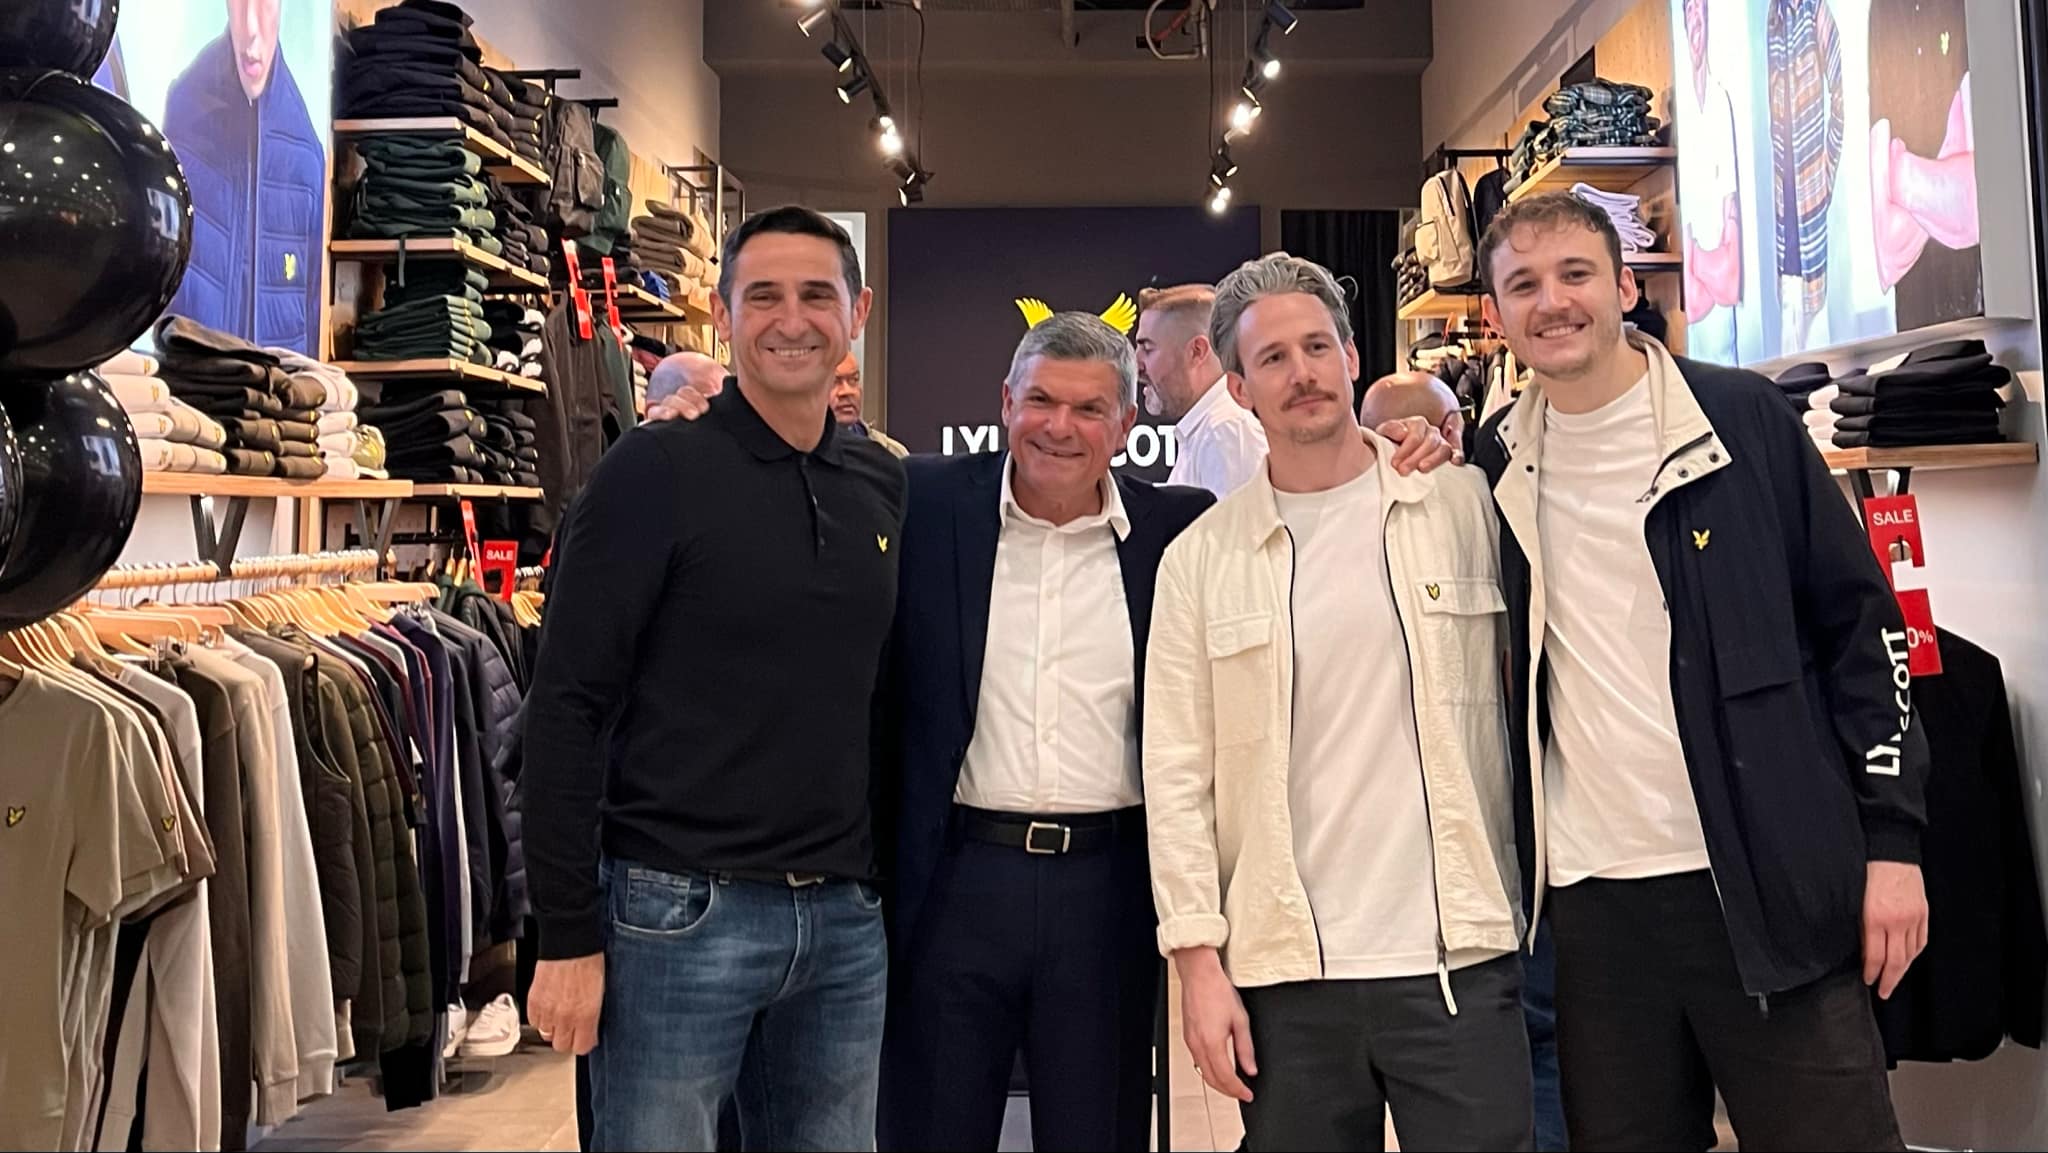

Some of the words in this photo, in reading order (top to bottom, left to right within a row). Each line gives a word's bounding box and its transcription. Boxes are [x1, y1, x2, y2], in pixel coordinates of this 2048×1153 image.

[1872, 508, 1914, 526] SALE
[486, 549, 514, 561] SALE
[1907, 627, 1934, 648] 0%
